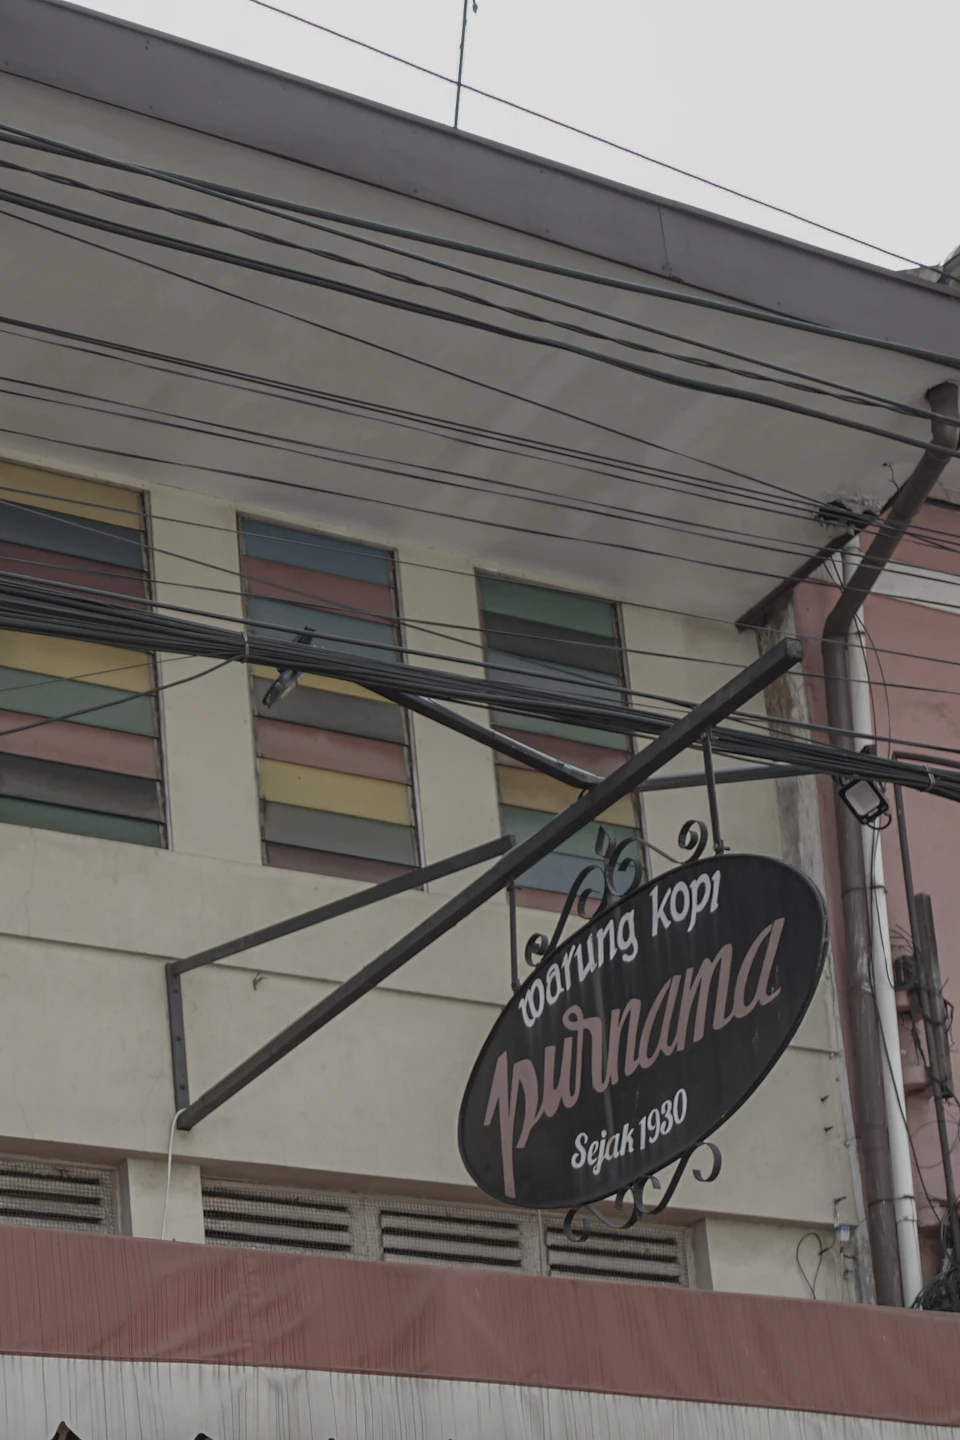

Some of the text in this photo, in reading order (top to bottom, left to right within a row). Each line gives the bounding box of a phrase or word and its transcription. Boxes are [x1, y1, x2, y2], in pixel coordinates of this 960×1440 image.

[518, 869, 722, 1028] warung kopi
[483, 917, 785, 1200] purnama
[570, 1088, 688, 1176] Sejak 1930
